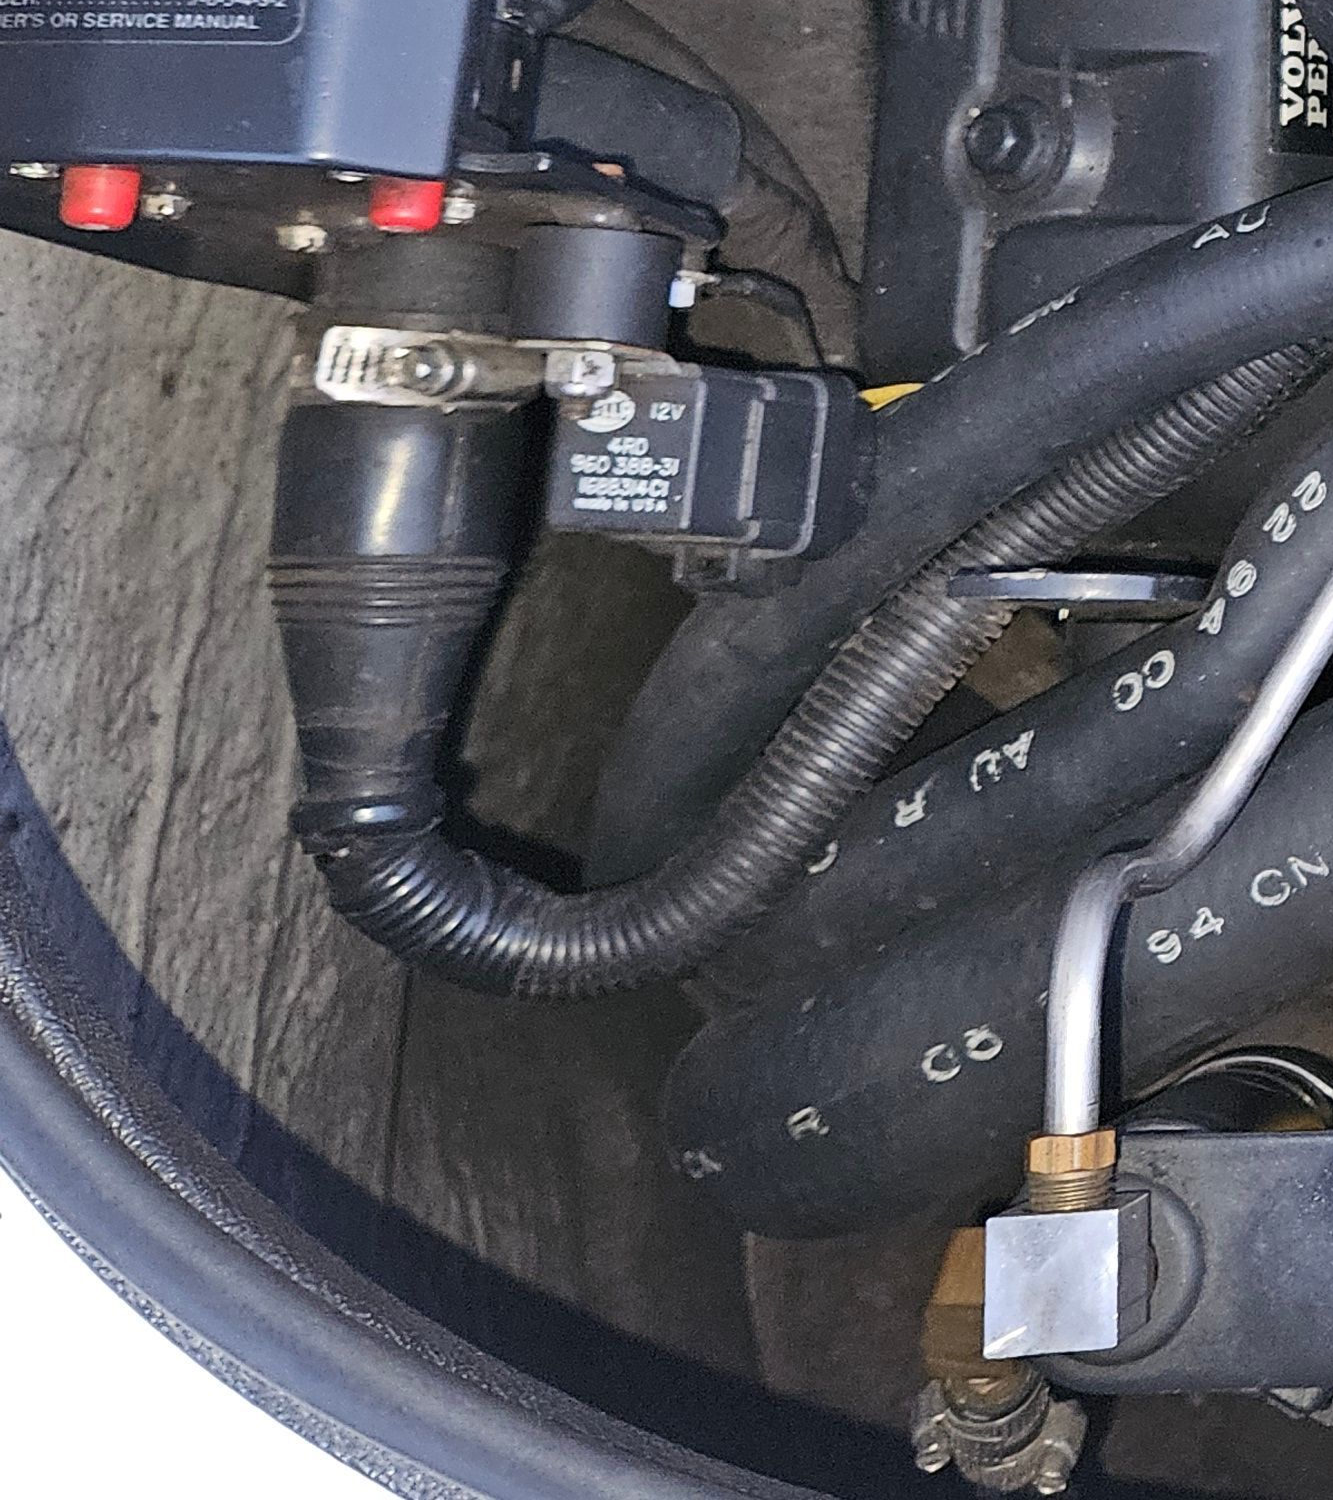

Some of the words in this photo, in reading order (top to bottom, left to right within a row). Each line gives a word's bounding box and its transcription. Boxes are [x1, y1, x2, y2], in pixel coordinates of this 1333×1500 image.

[50, 12, 78, 28] OR
[82, 12, 170, 28] SERVICE
[174, 13, 261, 30] MANUAL
